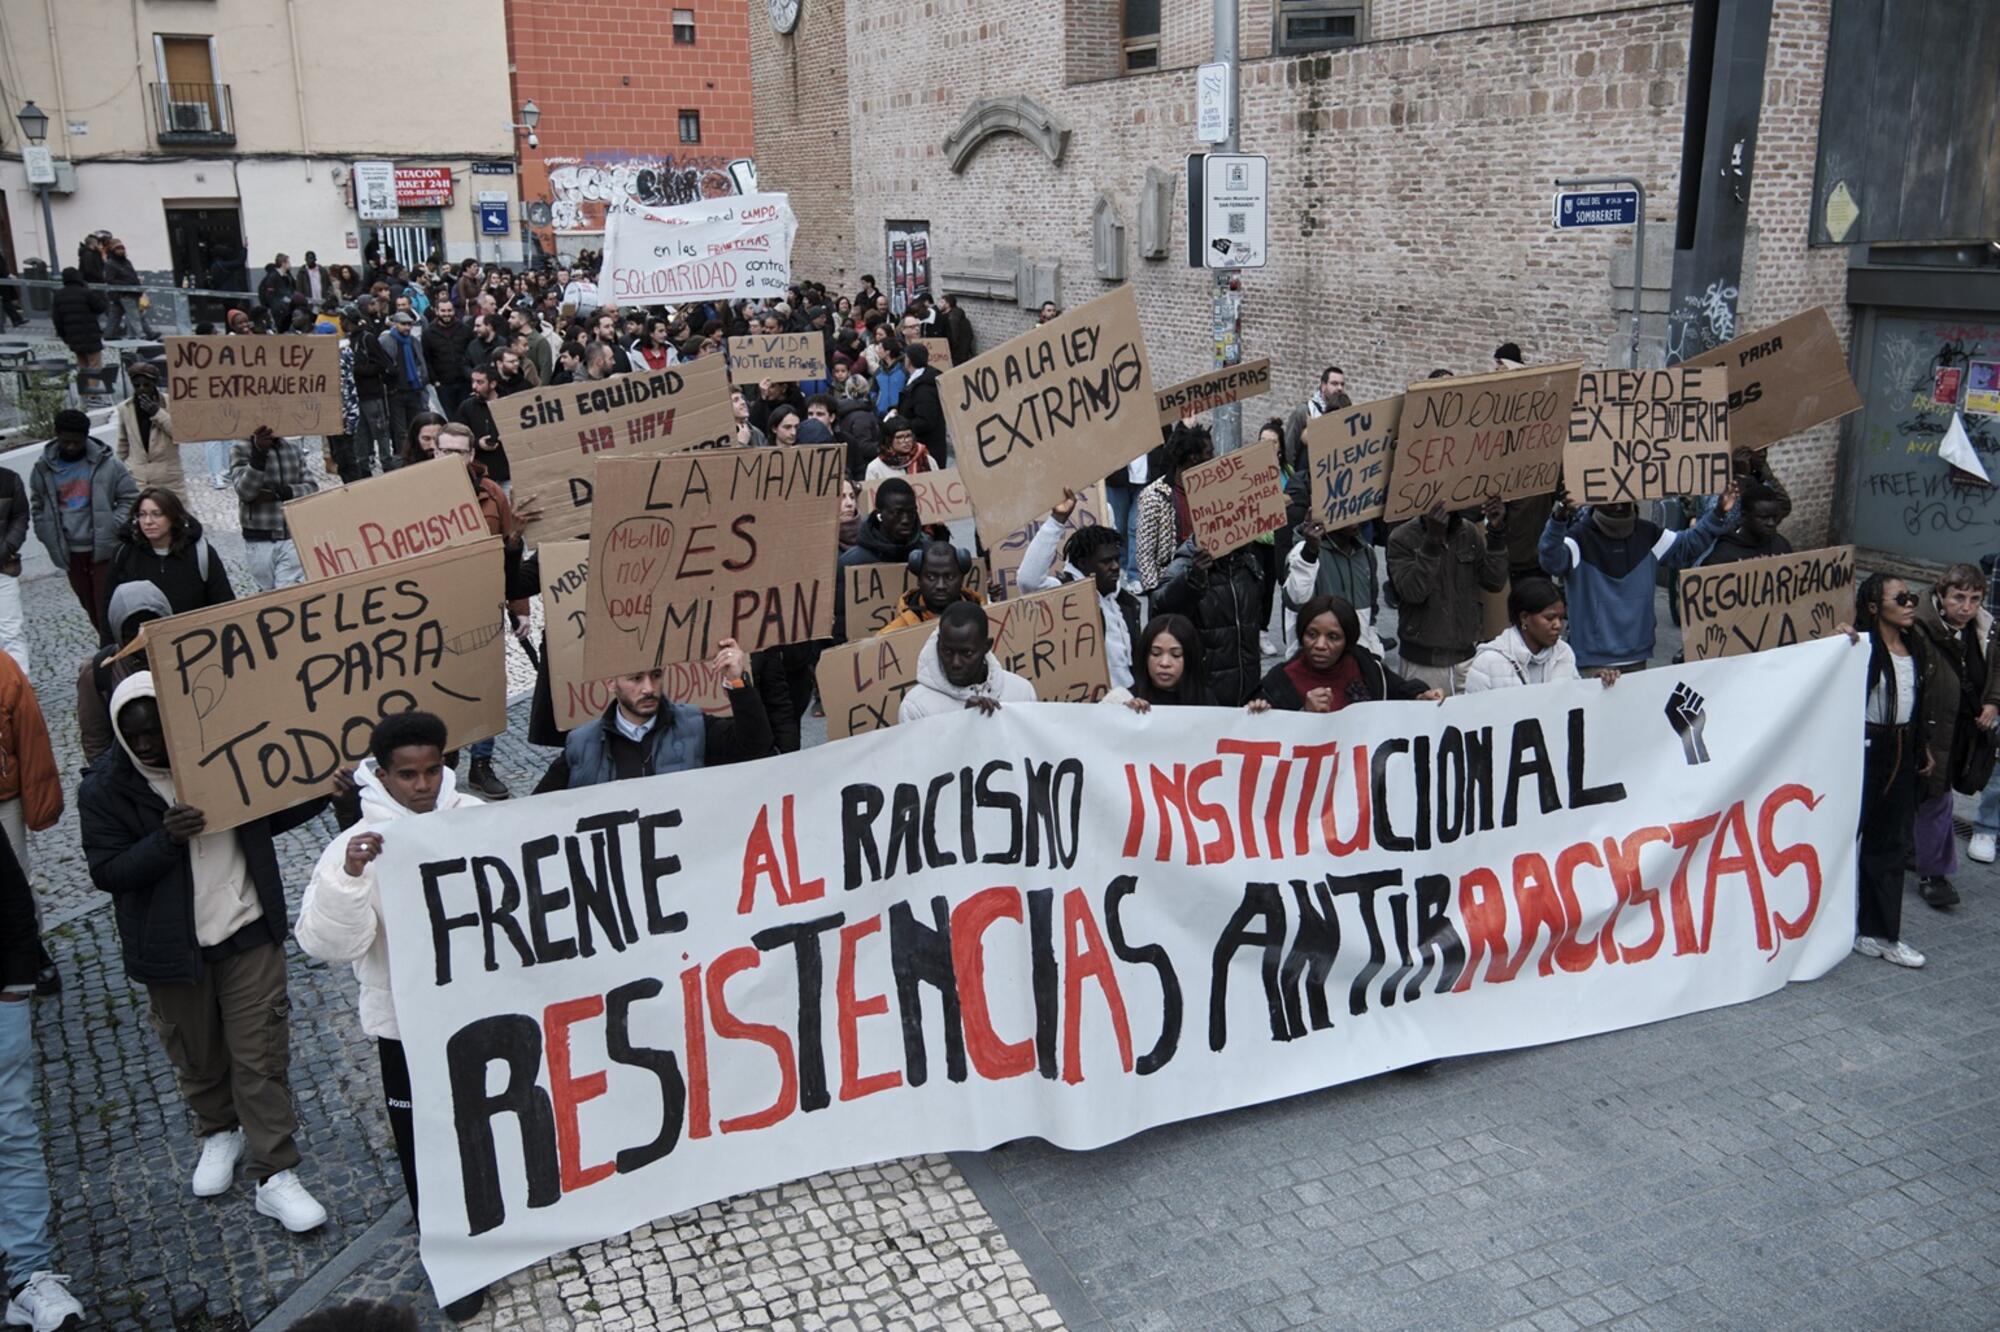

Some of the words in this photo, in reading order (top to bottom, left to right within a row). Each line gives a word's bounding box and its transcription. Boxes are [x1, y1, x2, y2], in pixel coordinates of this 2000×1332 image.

[1576, 197, 1591, 206] CALLE
[1591, 196, 1601, 206] DEL
[1576, 209, 1622, 223] SOMBRERETE
[653, 244, 671, 258] en
[677, 240, 698, 257] las
[612, 261, 737, 297] SOLIDARIDAD
[745, 258, 786, 273] contra
[173, 341, 213, 370] NO
[218, 345, 236, 367] A
[241, 344, 267, 368] LA
[279, 344, 315, 371] LEY
[748, 354, 785, 369] TIENE
[761, 335, 809, 353] VIDA
[1738, 335, 1784, 368] PARA
[960, 366, 1000, 412] NO
[1004, 354, 1023, 388] A
[1025, 340, 1056, 380] LA
[1061, 324, 1101, 368] LEY
[1603, 370, 1647, 402] LEY
[1651, 368, 1703, 402] DE
[172, 375, 199, 401] DE
[575, 370, 686, 417] EQUIDAD
[1159, 390, 1187, 412] LAS
[1186, 366, 1269, 404] FRONTERAS
[1179, 389, 1238, 419] MATAN
[627, 407, 677, 446] HAY
[1344, 411, 1373, 437] TU
[1413, 391, 1464, 429] NO
[1465, 390, 1559, 428] QUIERO
[1568, 400, 1730, 443] EXTRANJERIA
[1404, 436, 1457, 478] SER
[1464, 423, 1565, 466] MANTERO
[1613, 438, 1672, 467] NOS
[644, 458, 711, 512] LA
[729, 446, 844, 501] MANTA
[1185, 455, 1245, 495] MBAYE
[1323, 467, 1354, 508] NO
[1359, 460, 1383, 483] TE
[1583, 452, 1730, 503] EXPLOTA
[1868, 470, 1920, 497] FREE
[912, 481, 971, 515] RAC
[1239, 484, 1279, 509] SAMBA
[1325, 486, 1387, 525] PROTEG
[1394, 479, 1445, 514] SOY
[359, 501, 482, 565] RACISMO
[675, 513, 758, 581] ES
[549, 556, 589, 604] MBA
[853, 566, 885, 604] LA
[1681, 551, 1855, 628] REGULARIZACIÓN
[731, 578, 820, 653] PAN
[1731, 611, 1798, 653] YA
[170, 579, 430, 696] PAPELES
[296, 619, 444, 713] PARA
[852, 640, 903, 693] LA
[419, 808, 689, 987] FRENTE
[736, 794, 826, 915] AL
[840, 756, 1084, 892] RACISMO
[1121, 708, 1629, 867] INSTITUCIONAL
[446, 874, 1184, 1237] RESISTENCIAS
[1207, 783, 1827, 1053] ANTIRRACISTAS
[388, 1096, 413, 1108] Jom
